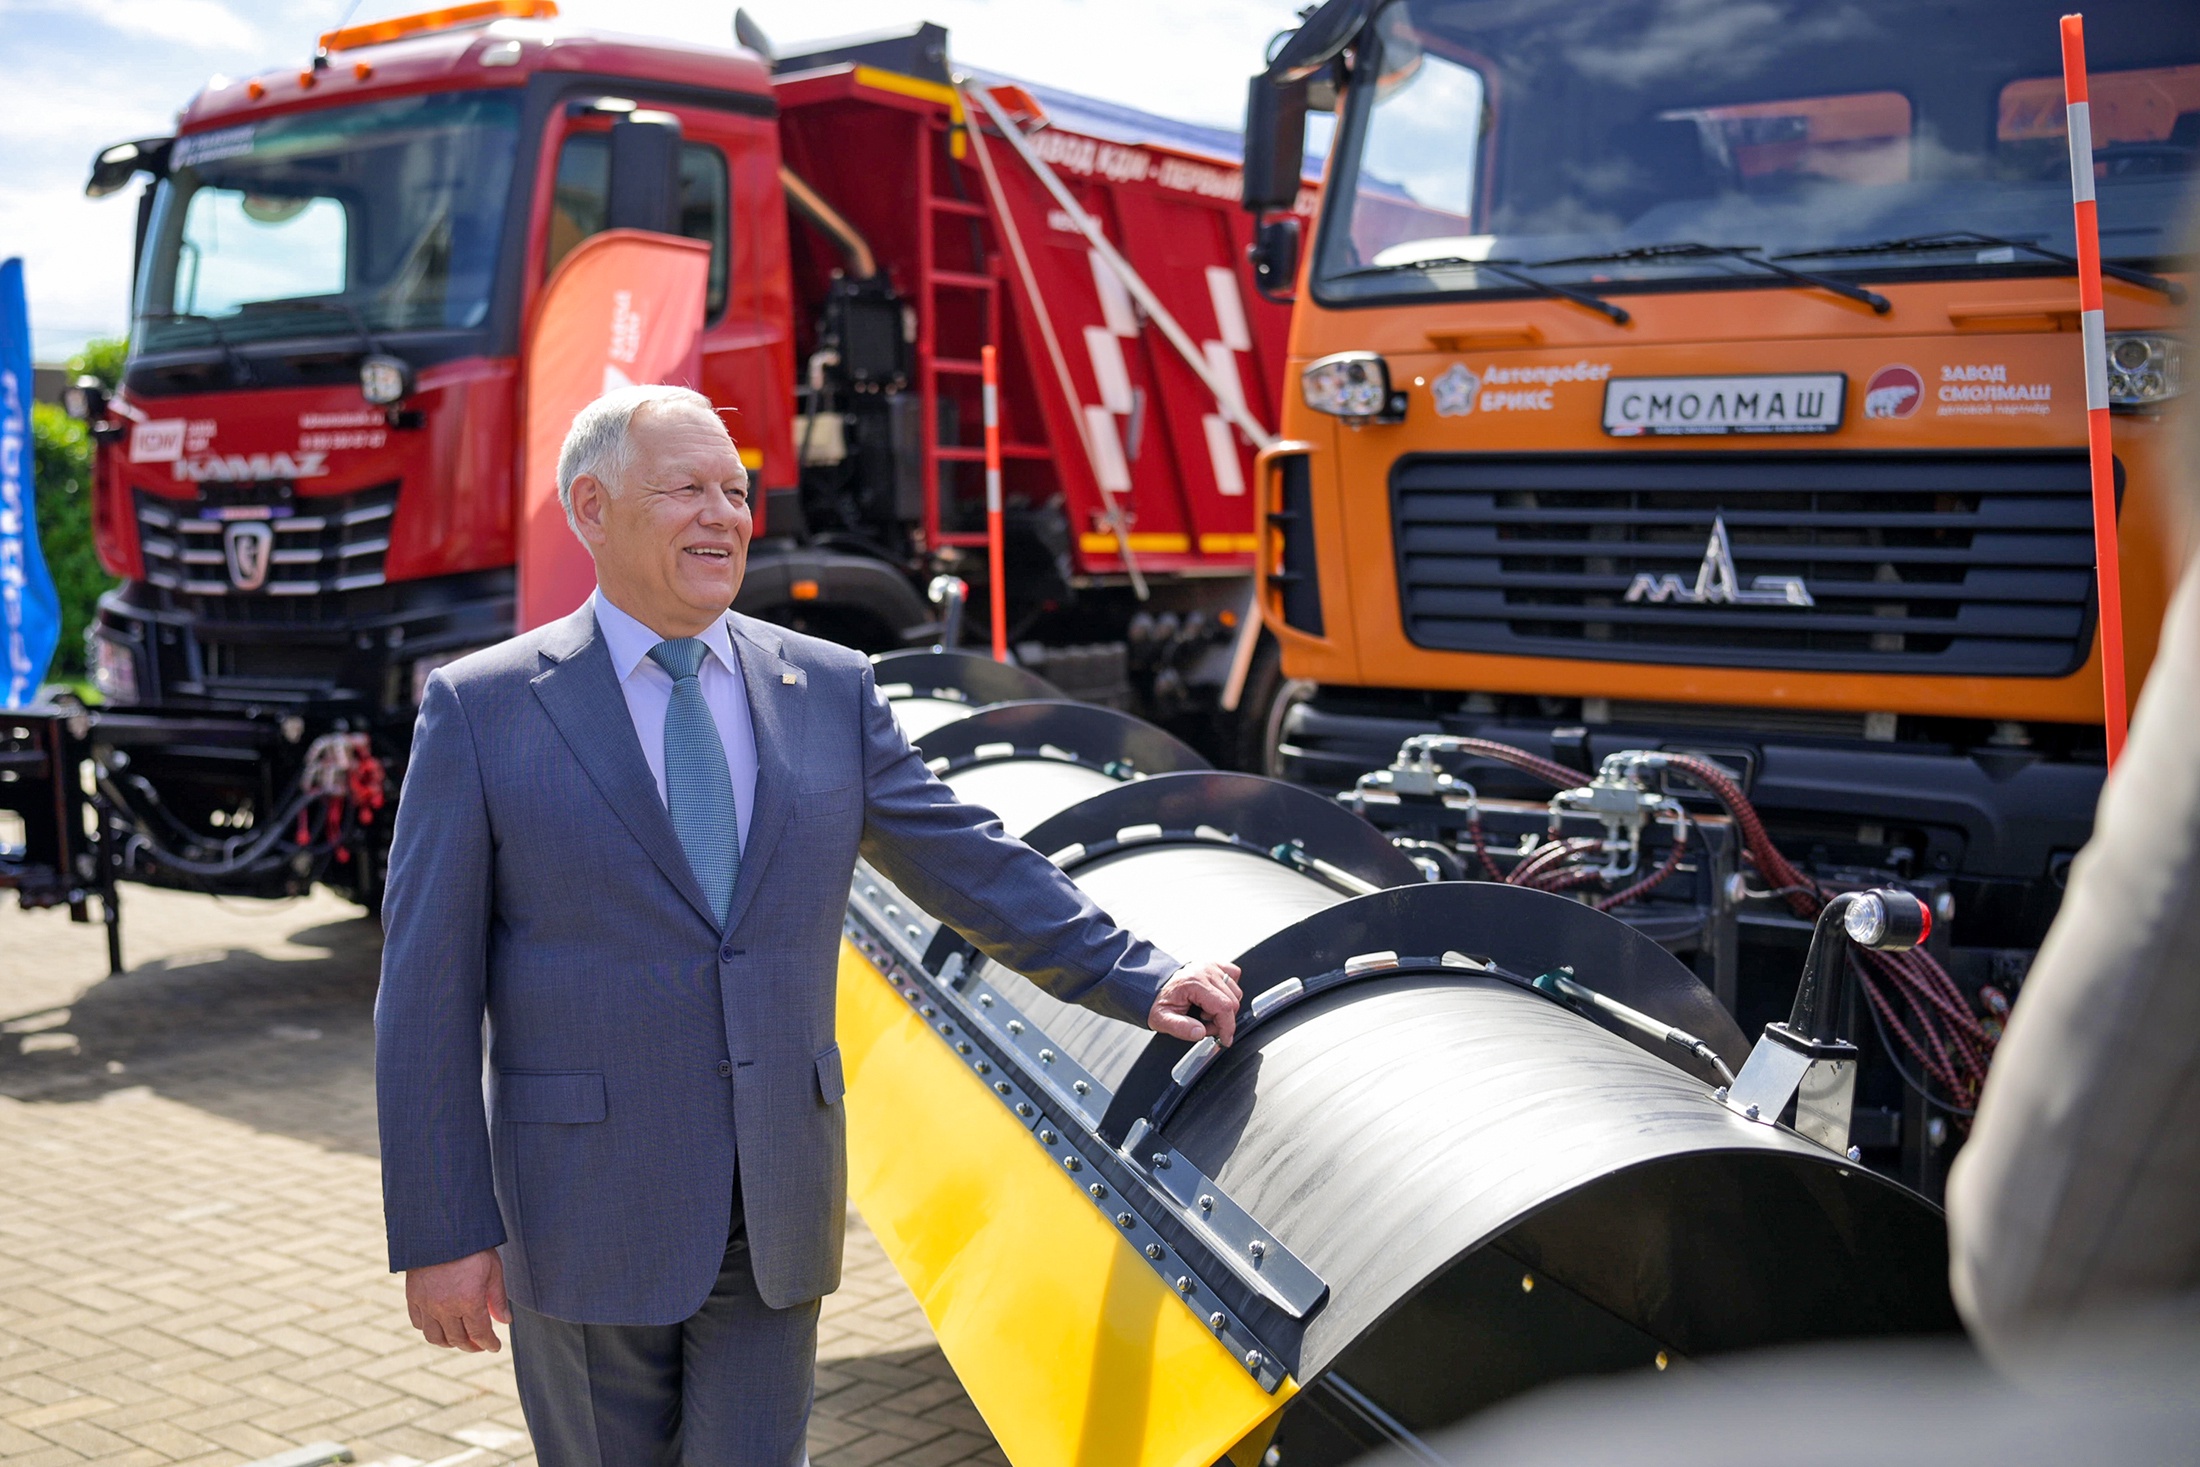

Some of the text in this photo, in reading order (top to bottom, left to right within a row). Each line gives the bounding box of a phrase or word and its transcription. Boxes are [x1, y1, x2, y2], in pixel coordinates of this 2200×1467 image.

[1482, 361, 1611, 386] Автопробег
[1940, 364, 2008, 383] ЗАВОД
[1480, 389, 1554, 412] БРИКС
[1938, 384, 2052, 402] СМОЛМАШ
[1621, 391, 1825, 421] СМОЛМАШ
[172, 451, 330, 482] KAMAZ
